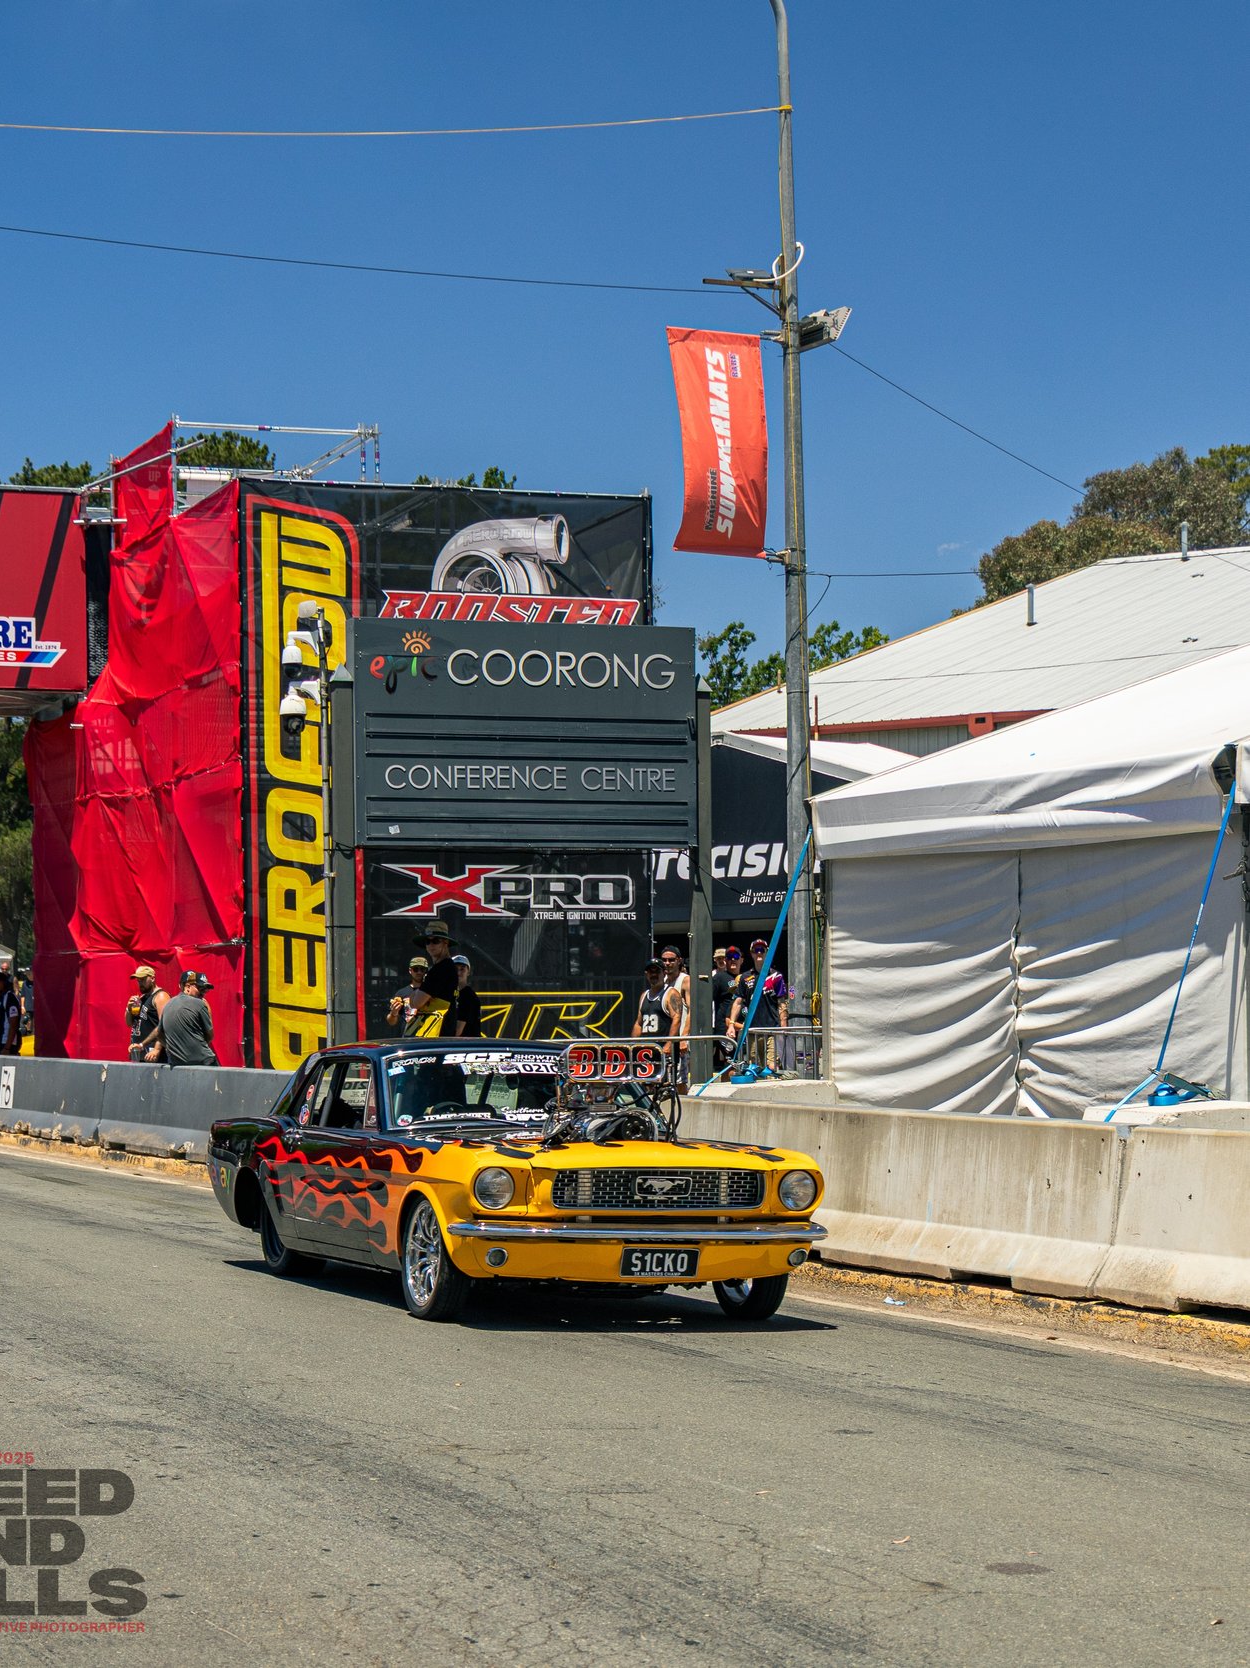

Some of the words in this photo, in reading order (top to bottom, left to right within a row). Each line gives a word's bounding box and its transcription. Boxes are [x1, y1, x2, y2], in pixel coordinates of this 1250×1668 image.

[447, 649, 676, 690] COORONG
[385, 764, 567, 791] CONFERENCE
[580, 765, 676, 792] CENTRE
[534, 911, 564, 920] XTREME
[566, 911, 597, 921] IGNITION
[599, 912, 636, 921] PRODUCTS
[641, 1014, 658, 1032] 23
[569, 1048, 655, 1078] BDS
